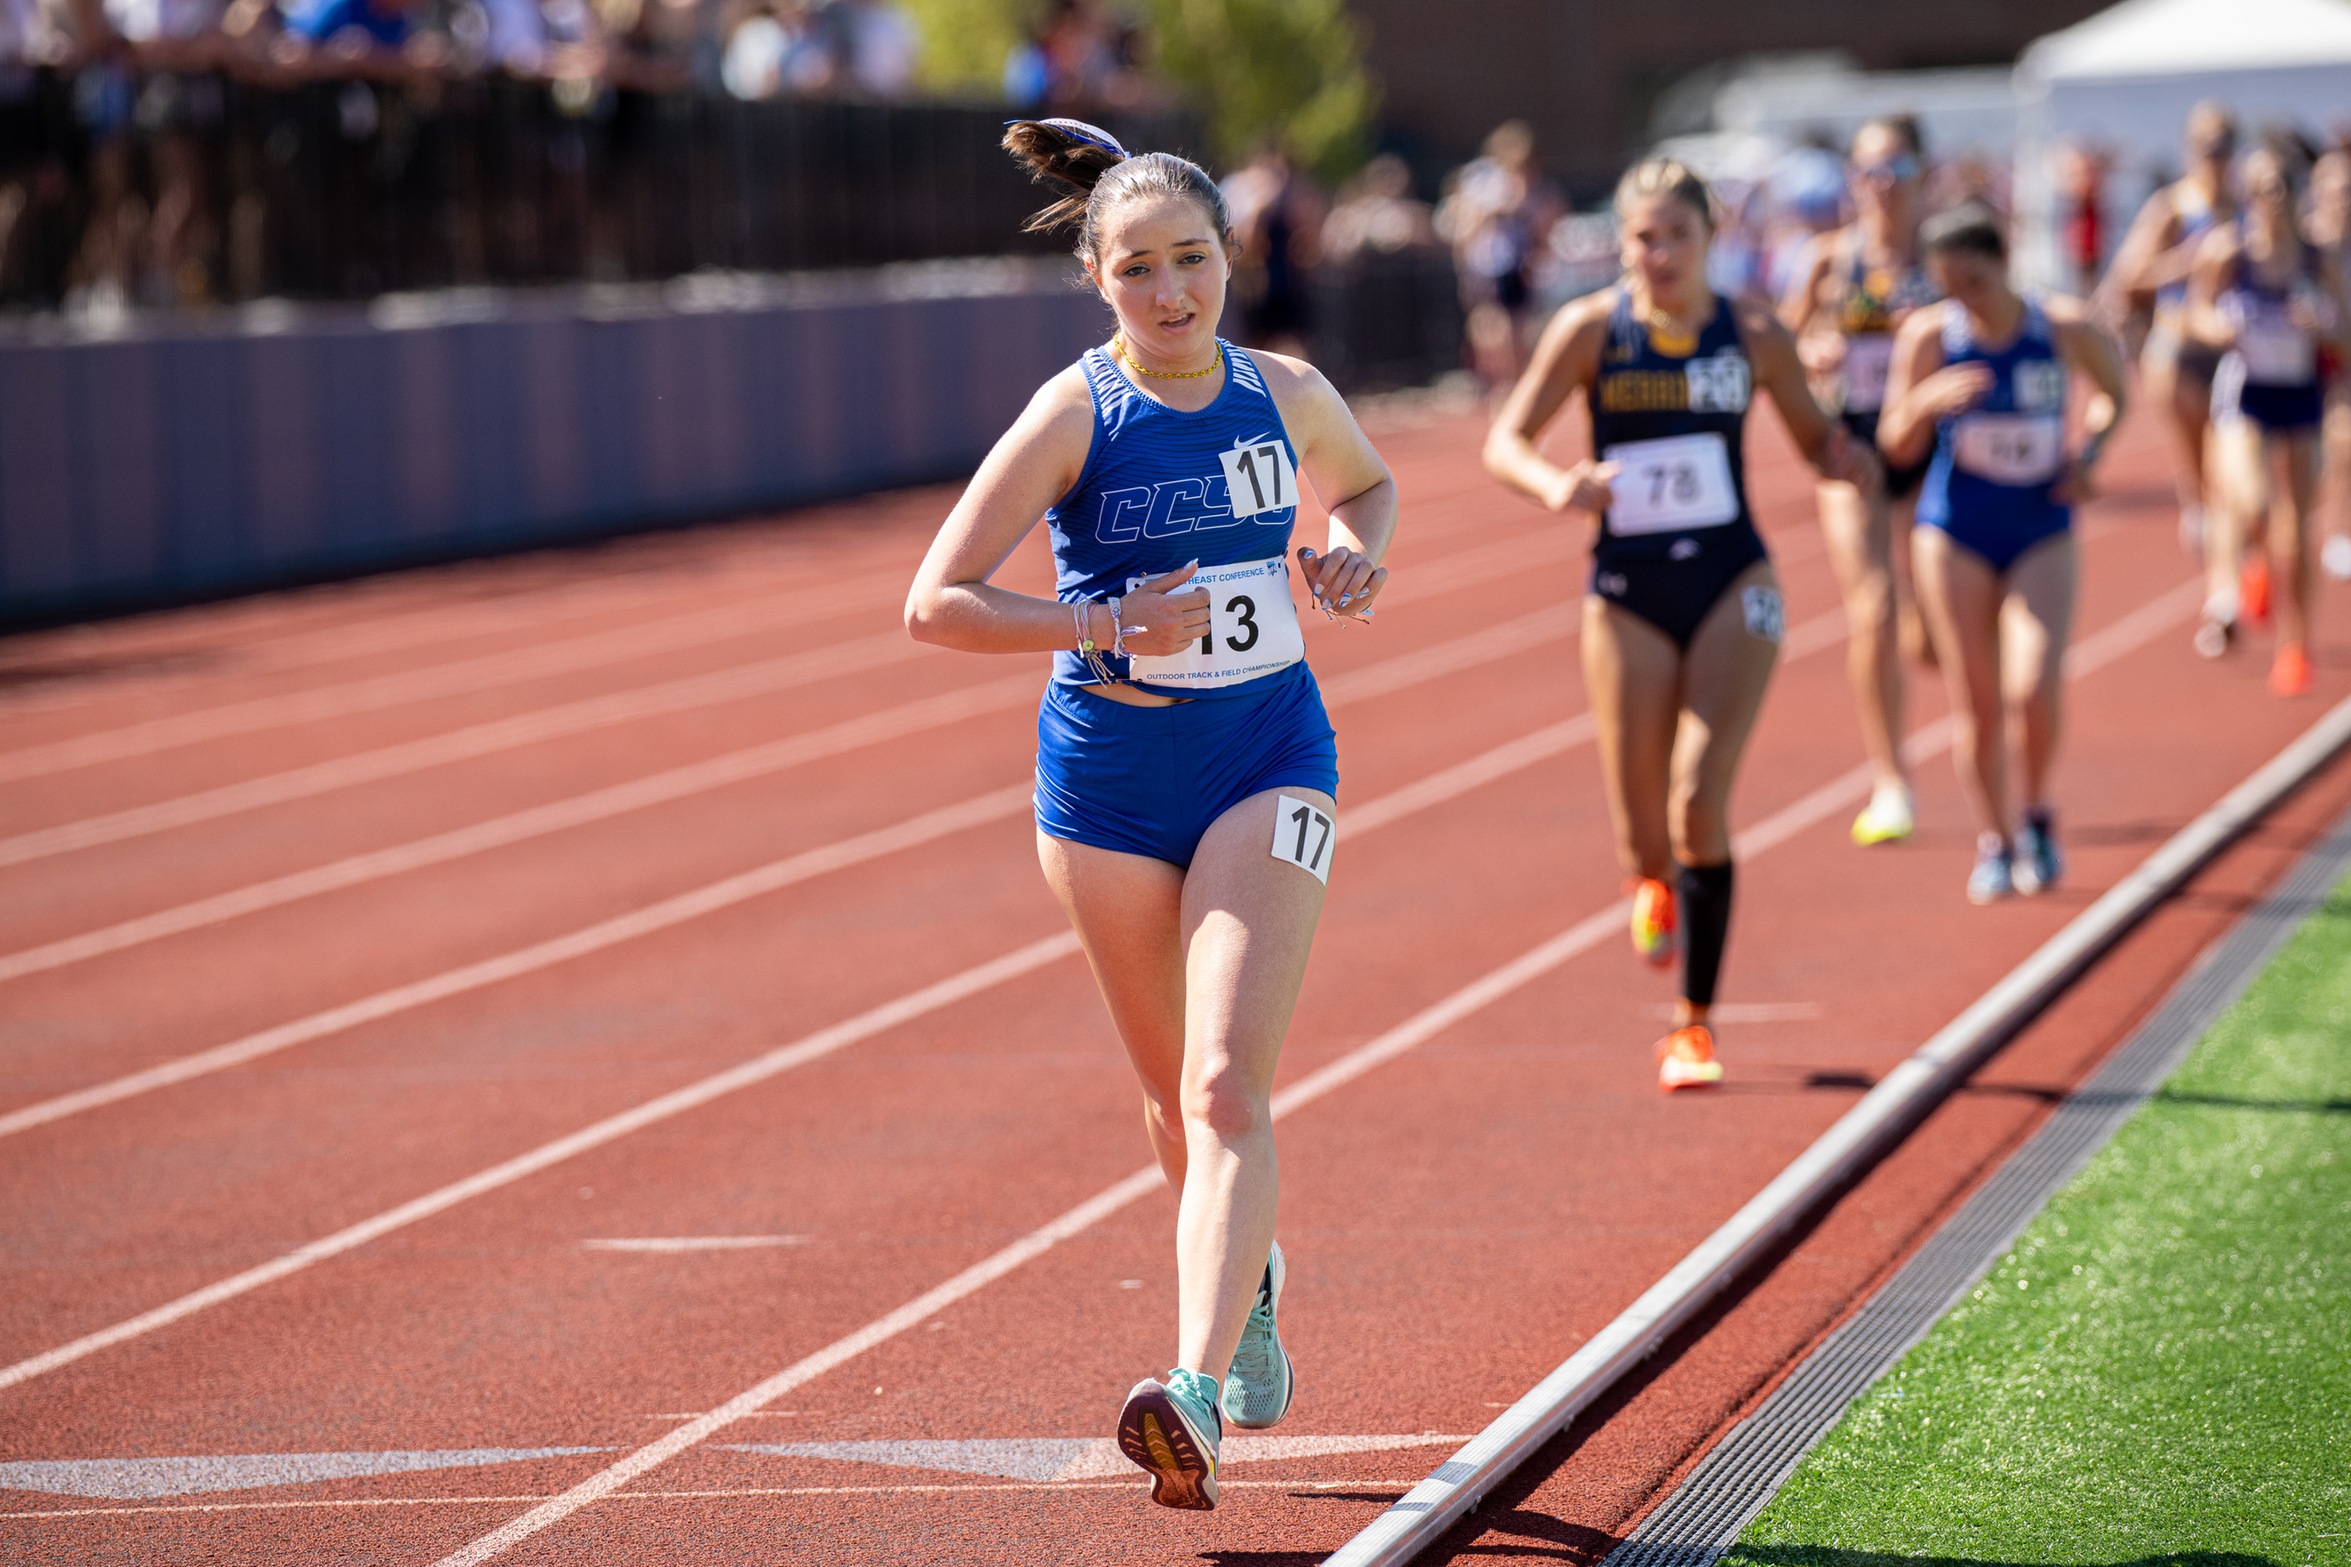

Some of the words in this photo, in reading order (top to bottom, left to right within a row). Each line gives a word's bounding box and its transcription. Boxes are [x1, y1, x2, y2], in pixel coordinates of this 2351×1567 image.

[1601, 370, 1688, 412] MERRI
[1236, 445, 1281, 510] 17
[1642, 460, 1700, 507] 78
[1095, 475, 1294, 544] CCS
[1219, 567, 1265, 582] CONFERENCE
[1146, 673, 1186, 681] OUTDOOR
[1187, 671, 1213, 680] TRACK
[1214, 671, 1220, 679] &
[1221, 668, 1242, 677] FIELD
[1291, 805, 1331, 871] 17
